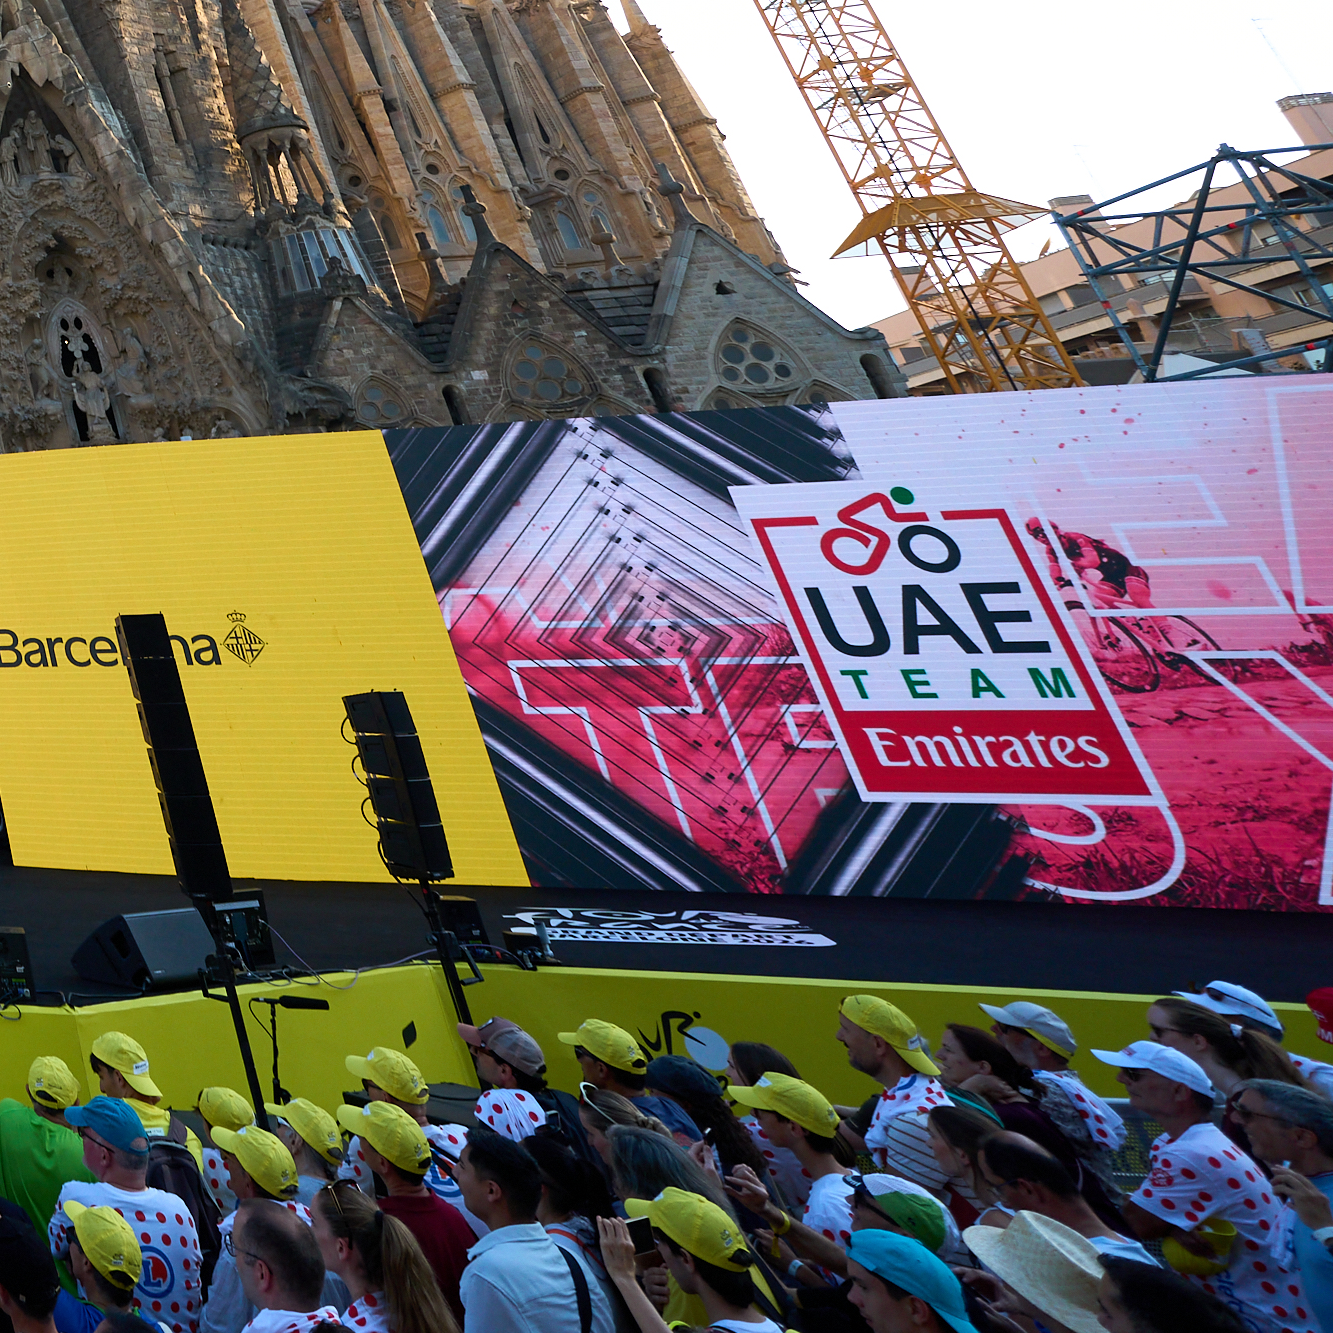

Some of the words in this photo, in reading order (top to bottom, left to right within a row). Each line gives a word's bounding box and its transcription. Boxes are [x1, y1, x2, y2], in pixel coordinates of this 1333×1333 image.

[803, 581, 1052, 658] UAE
[840, 667, 1076, 699] TEAM
[862, 725, 1110, 768] Emirates
